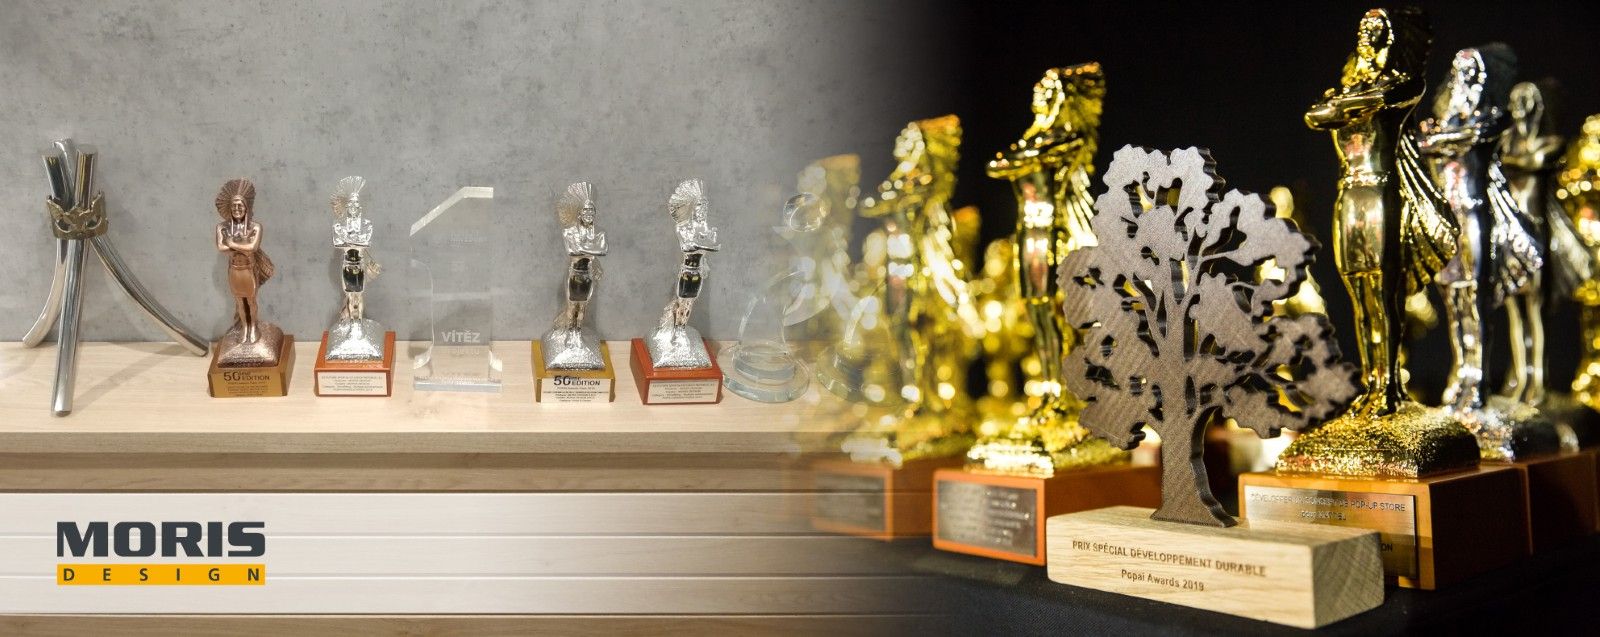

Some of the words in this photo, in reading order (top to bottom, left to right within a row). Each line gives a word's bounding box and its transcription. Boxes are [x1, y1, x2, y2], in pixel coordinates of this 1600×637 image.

[441, 330, 480, 343] VÍTĚZ
[1350, 500, 1378, 510] POP-UP
[1379, 502, 1406, 512] STORE
[1072, 540, 1091, 551] PRIX
[1092, 542, 1128, 557] SPÉCIAL
[1130, 547, 1212, 569] DÉVELOPPEMENT
[1215, 560, 1267, 578] DURABLE
[1121, 569, 1145, 582] Popai
[1147, 573, 1180, 588] Awards
[1182, 579, 1205, 592] 2019
